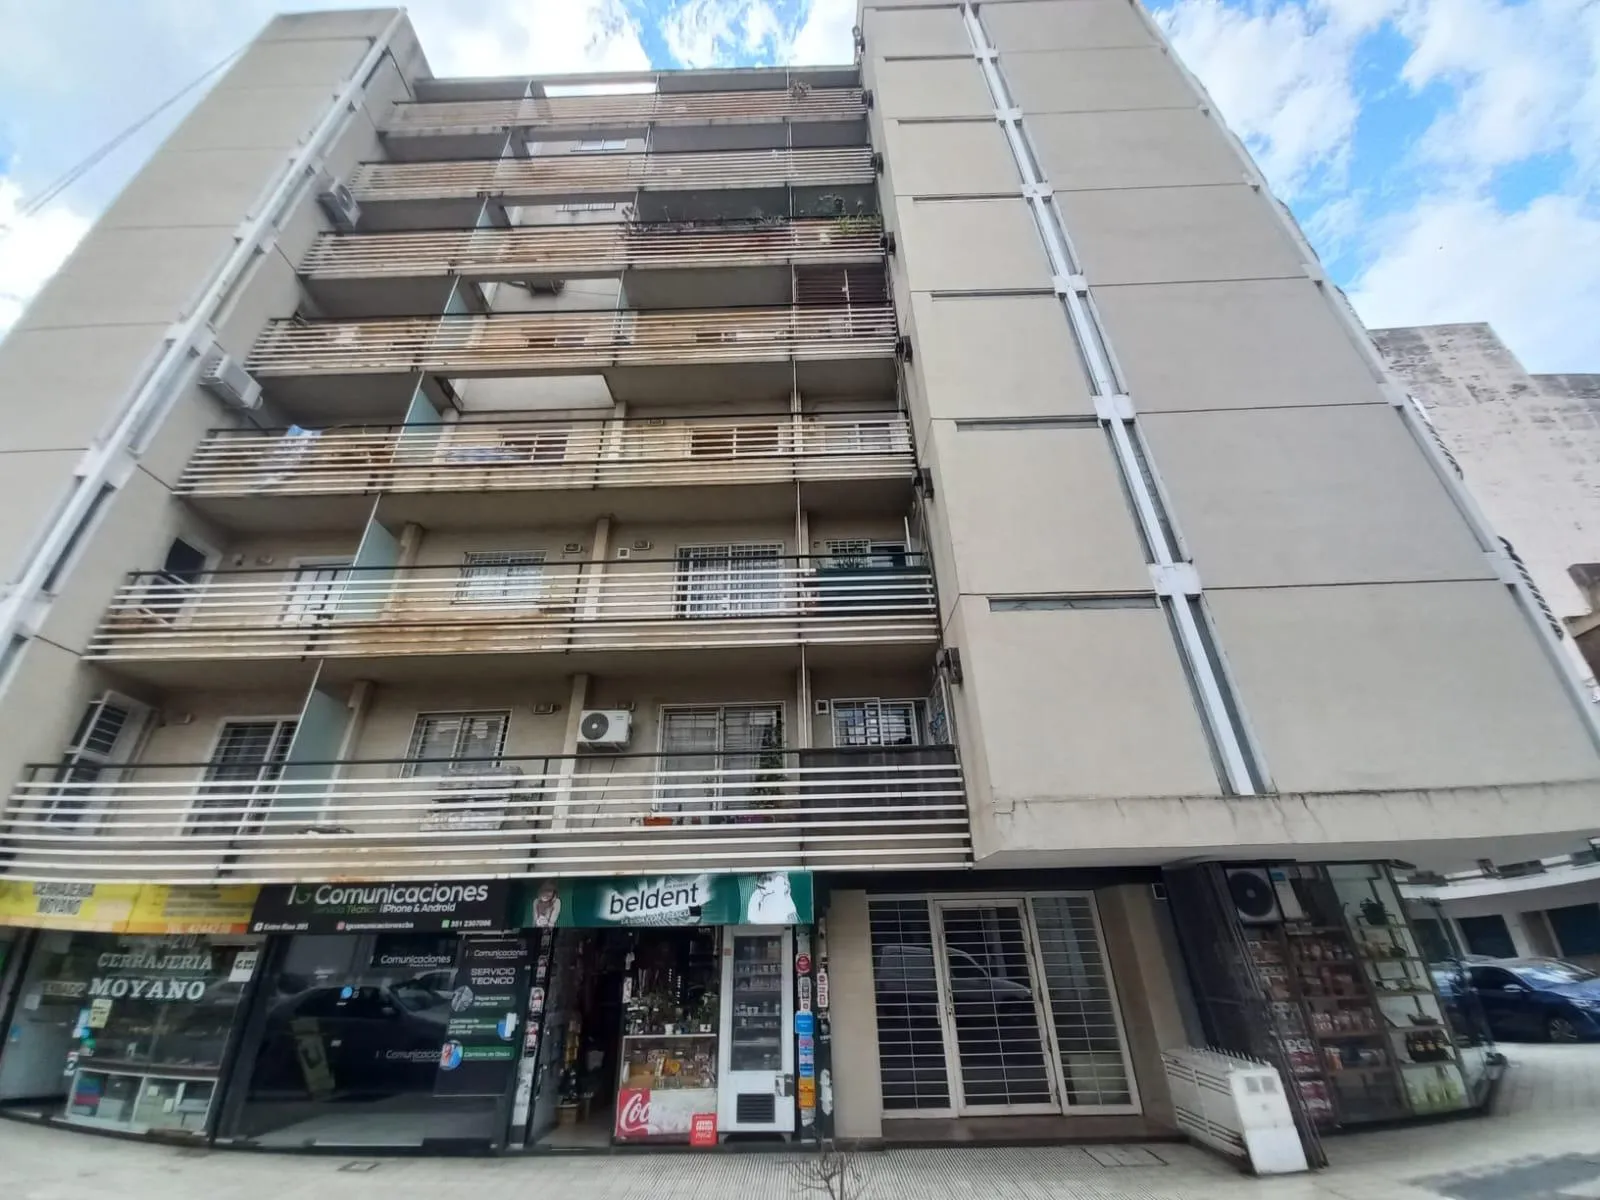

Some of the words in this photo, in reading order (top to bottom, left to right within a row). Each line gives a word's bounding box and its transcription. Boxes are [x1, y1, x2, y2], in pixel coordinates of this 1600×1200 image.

[315, 882, 489, 905] Comunicaciones
[609, 882, 699, 915] beldent
[413, 904, 420, 913] &
[420, 902, 457, 913] Android
[474, 949, 528, 958] Comunicaciones
[97, 953, 213, 970] CERRAJERIA
[380, 954, 451, 965] Comunicaciones
[470, 967, 516, 976] SERVICIO
[471, 977, 515, 985] TECNICO
[88, 977, 206, 1000] MOYANO
[385, 1049, 442, 1059] Comunicacio
